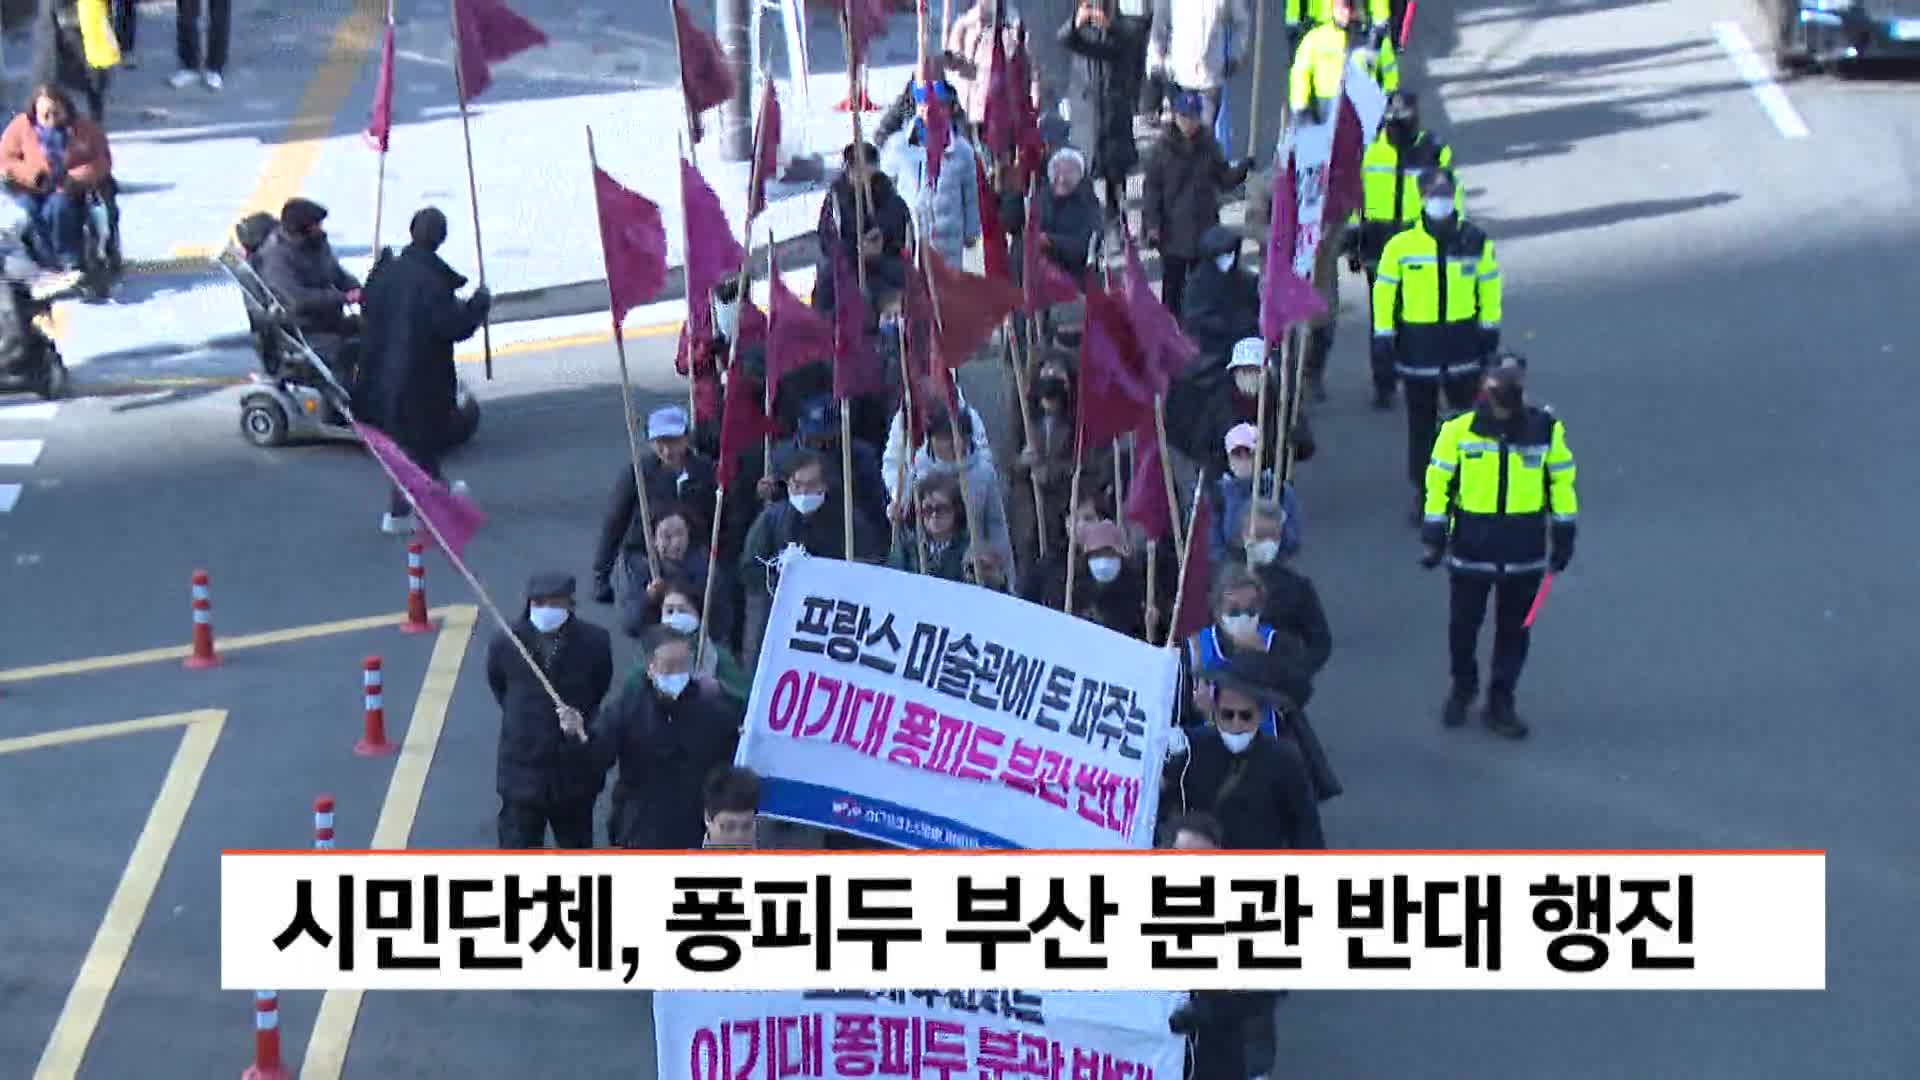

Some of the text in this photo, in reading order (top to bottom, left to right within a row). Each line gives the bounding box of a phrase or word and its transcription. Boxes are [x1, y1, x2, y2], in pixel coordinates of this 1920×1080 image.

[789, 596, 902, 674] 프랑스
[902, 620, 1046, 721] 미술관에
[1034, 664, 1077, 733] 돈
[768, 668, 896, 759] 이기대
[888, 701, 1006, 783] 퐁피두
[690, 1013, 823, 1080] 이기대
[832, 1014, 968, 1080] 퐁피두
